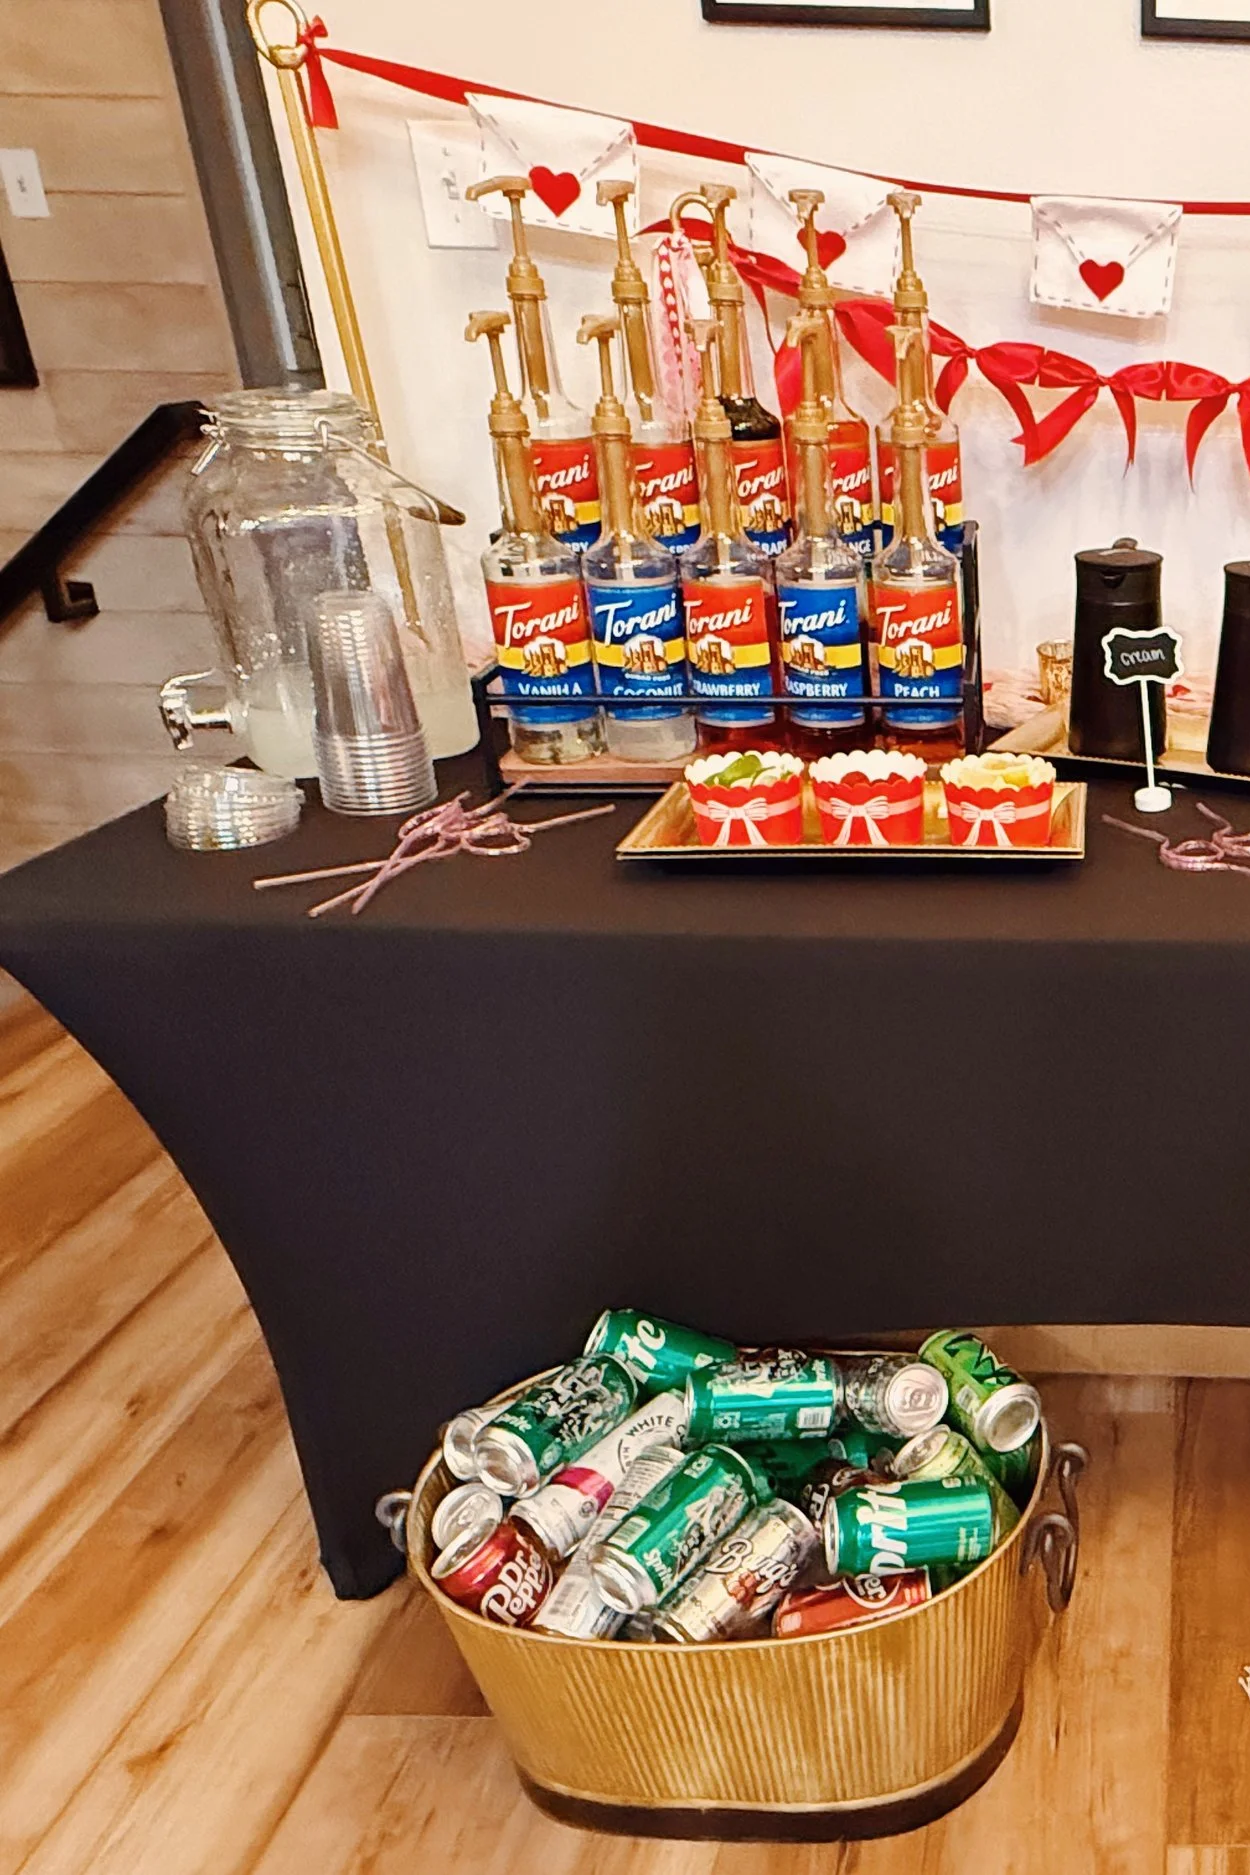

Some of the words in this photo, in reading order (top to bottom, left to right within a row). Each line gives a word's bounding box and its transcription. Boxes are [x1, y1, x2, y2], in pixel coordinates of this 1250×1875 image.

[495, 594, 579, 649] Torani
[595, 593, 677, 647] Torani
[683, 597, 753, 634] Torani
[778, 599, 847, 642] Torani
[876, 600, 952, 647] Torani
[1119, 648, 1166, 668] cream
[894, 683, 940, 697] PEACH
[624, 1414, 675, 1437] WHITE
[497, 1550, 529, 1594] Dr
